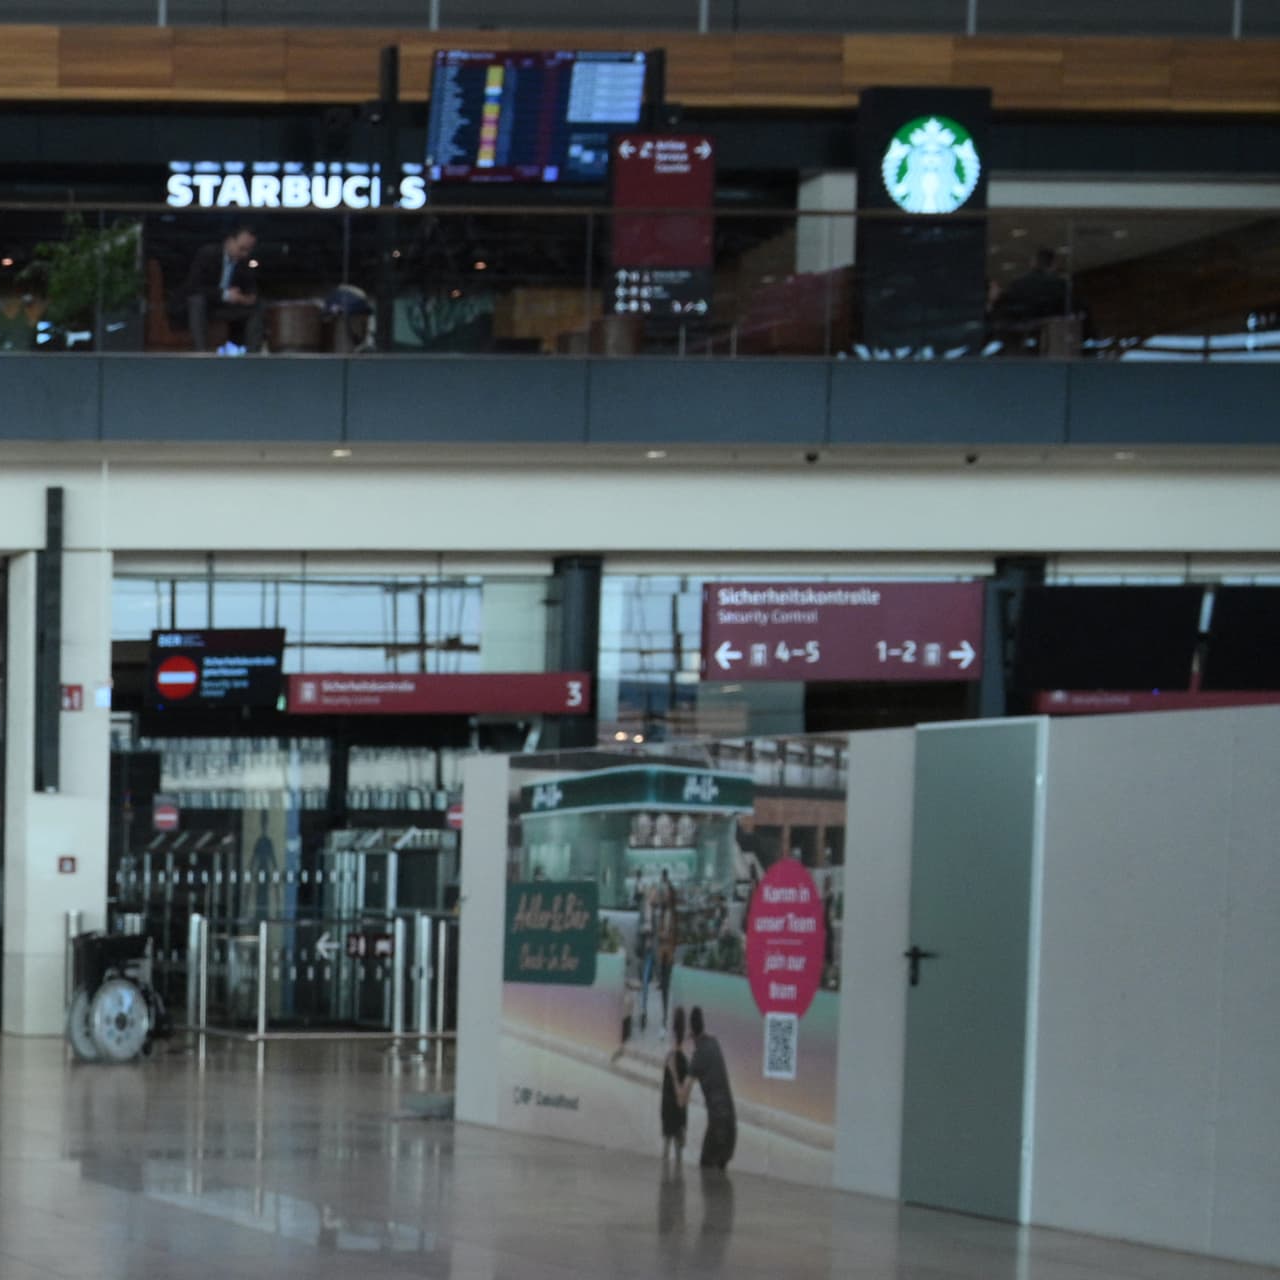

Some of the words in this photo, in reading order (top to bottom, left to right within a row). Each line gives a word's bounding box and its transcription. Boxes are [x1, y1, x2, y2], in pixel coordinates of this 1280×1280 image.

[167, 175, 427, 209] STARBUCS
[718, 588, 881, 606] Sicherheitskontrolle
[718, 609, 769, 625] Security
[773, 608, 818, 624] Control
[567, 682, 582, 706] 3
[786, 913, 816, 933] Team
